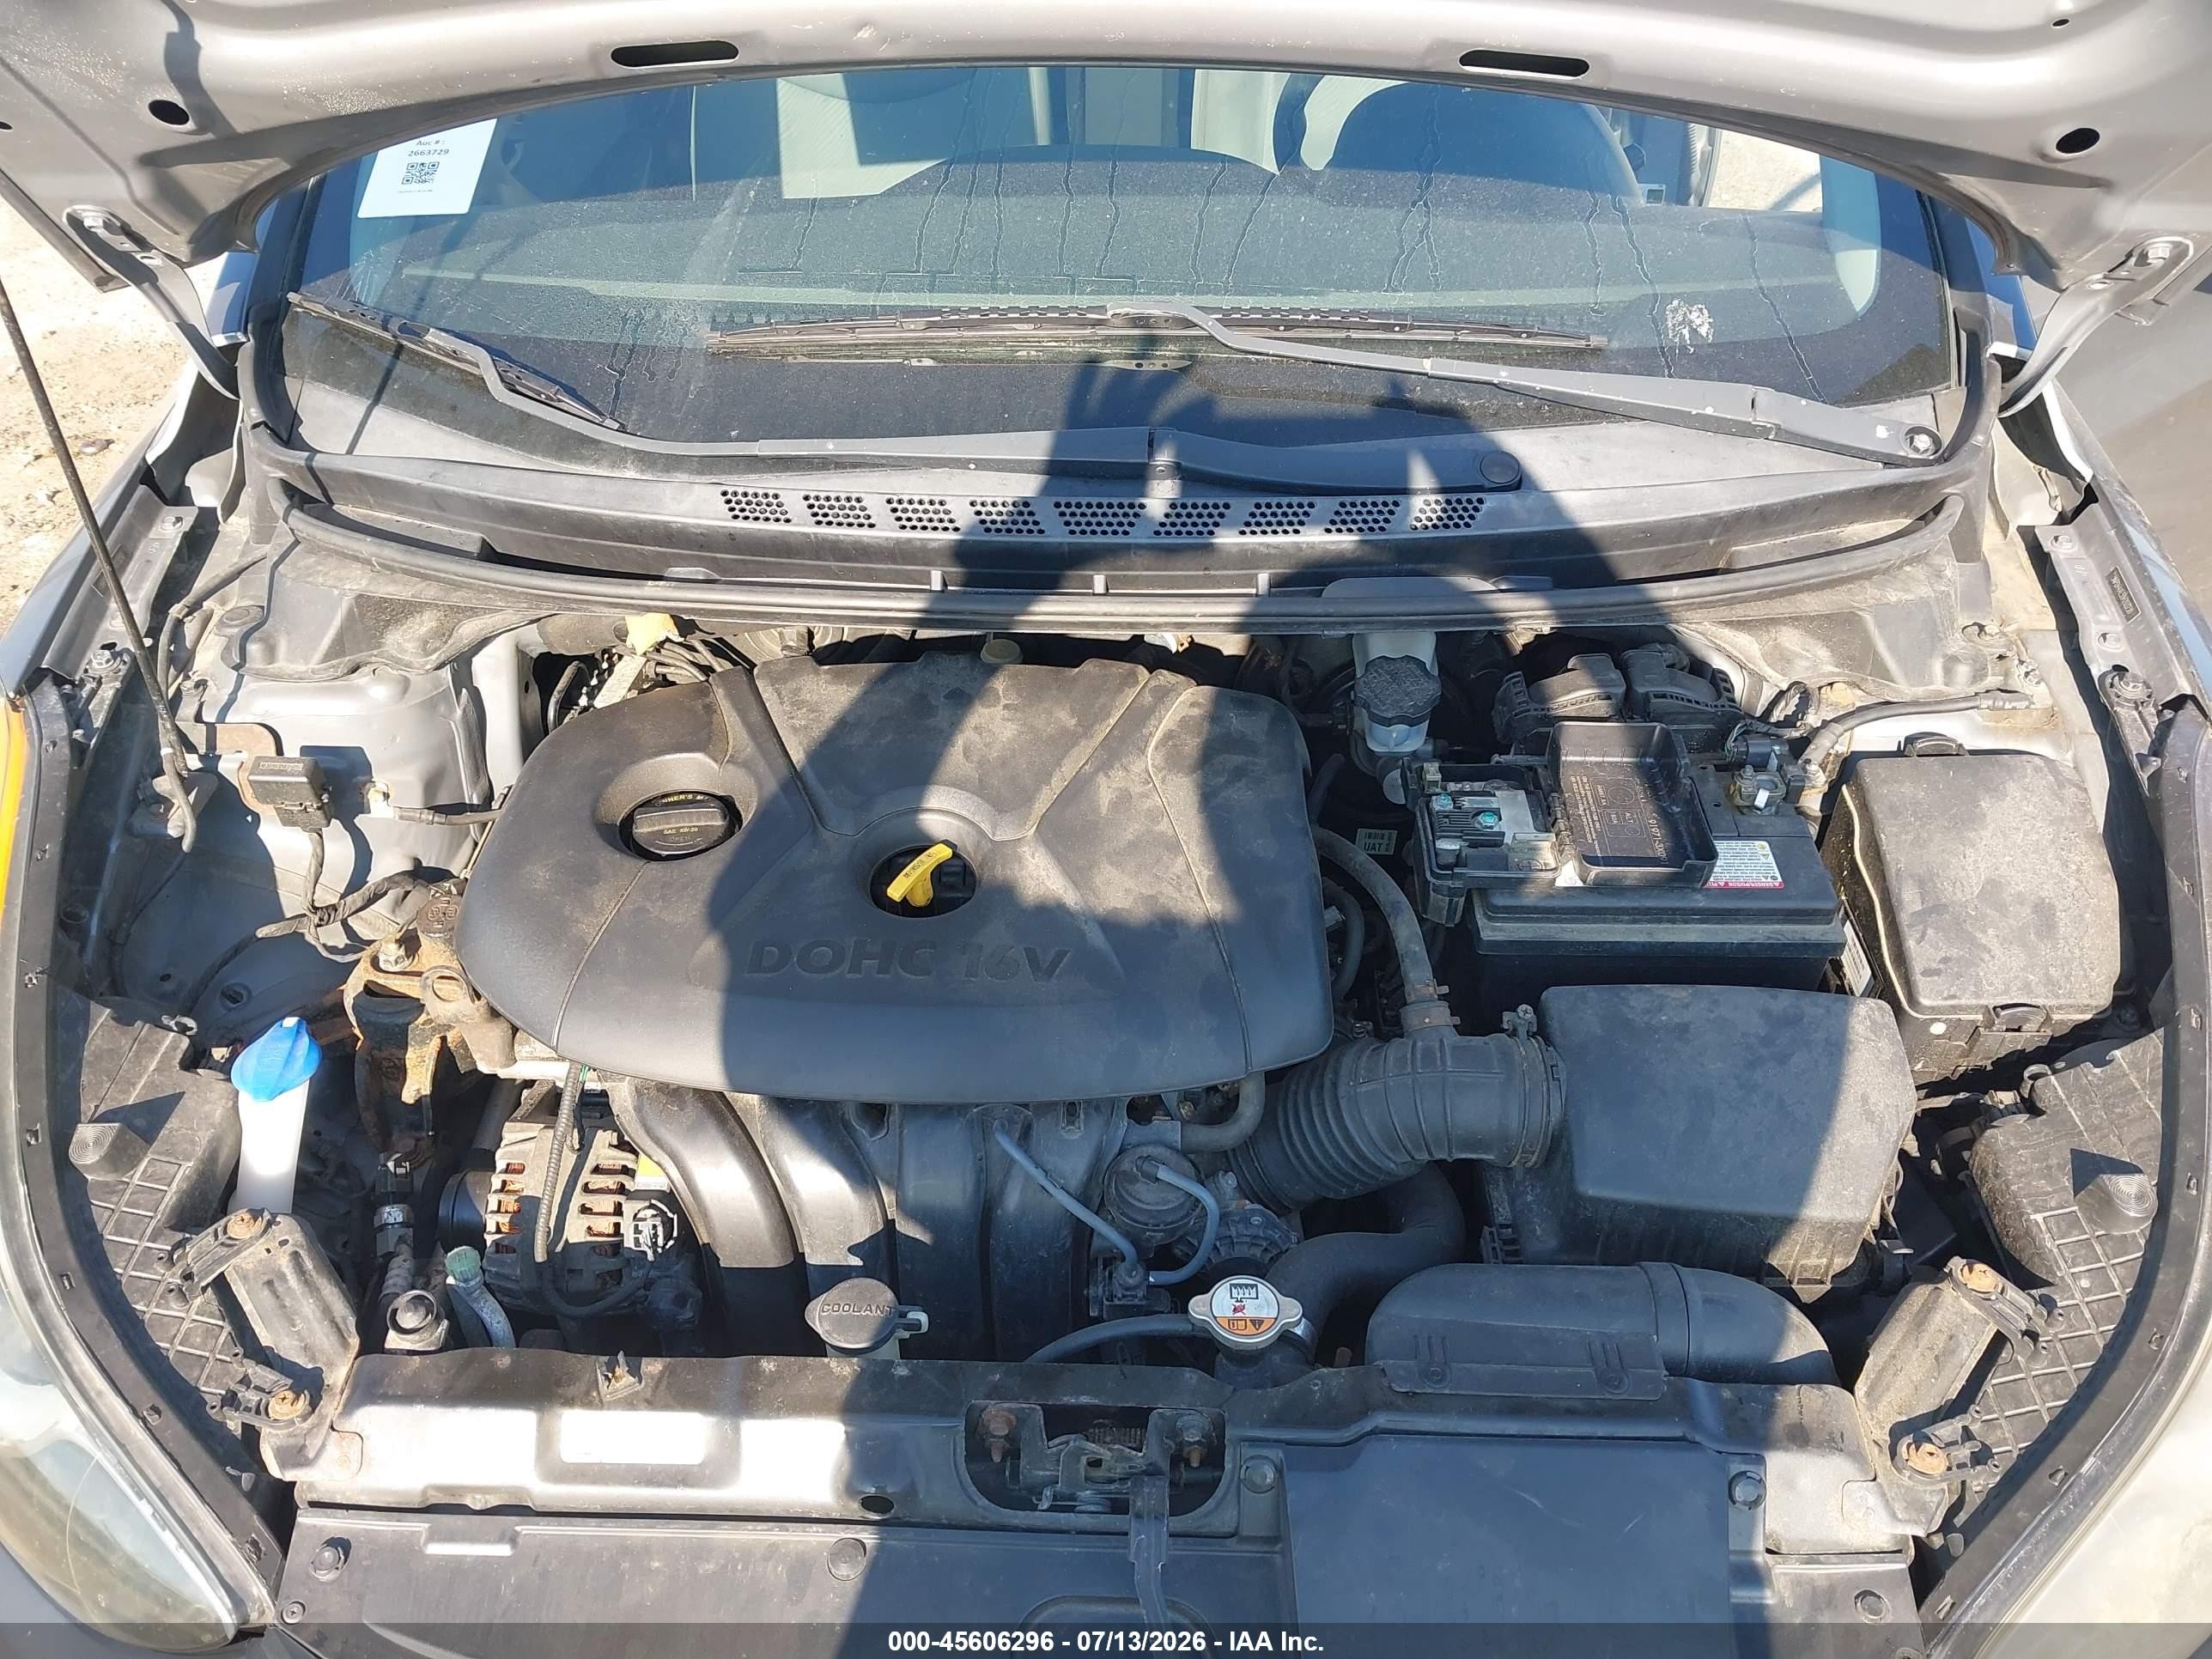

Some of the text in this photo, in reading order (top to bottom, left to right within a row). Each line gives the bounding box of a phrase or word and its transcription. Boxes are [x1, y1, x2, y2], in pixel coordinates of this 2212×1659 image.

[1625, 811, 1634, 823] ALT
[744, 939, 1072, 983] DOHC 16V
[821, 1303, 895, 1317] COOLANT
